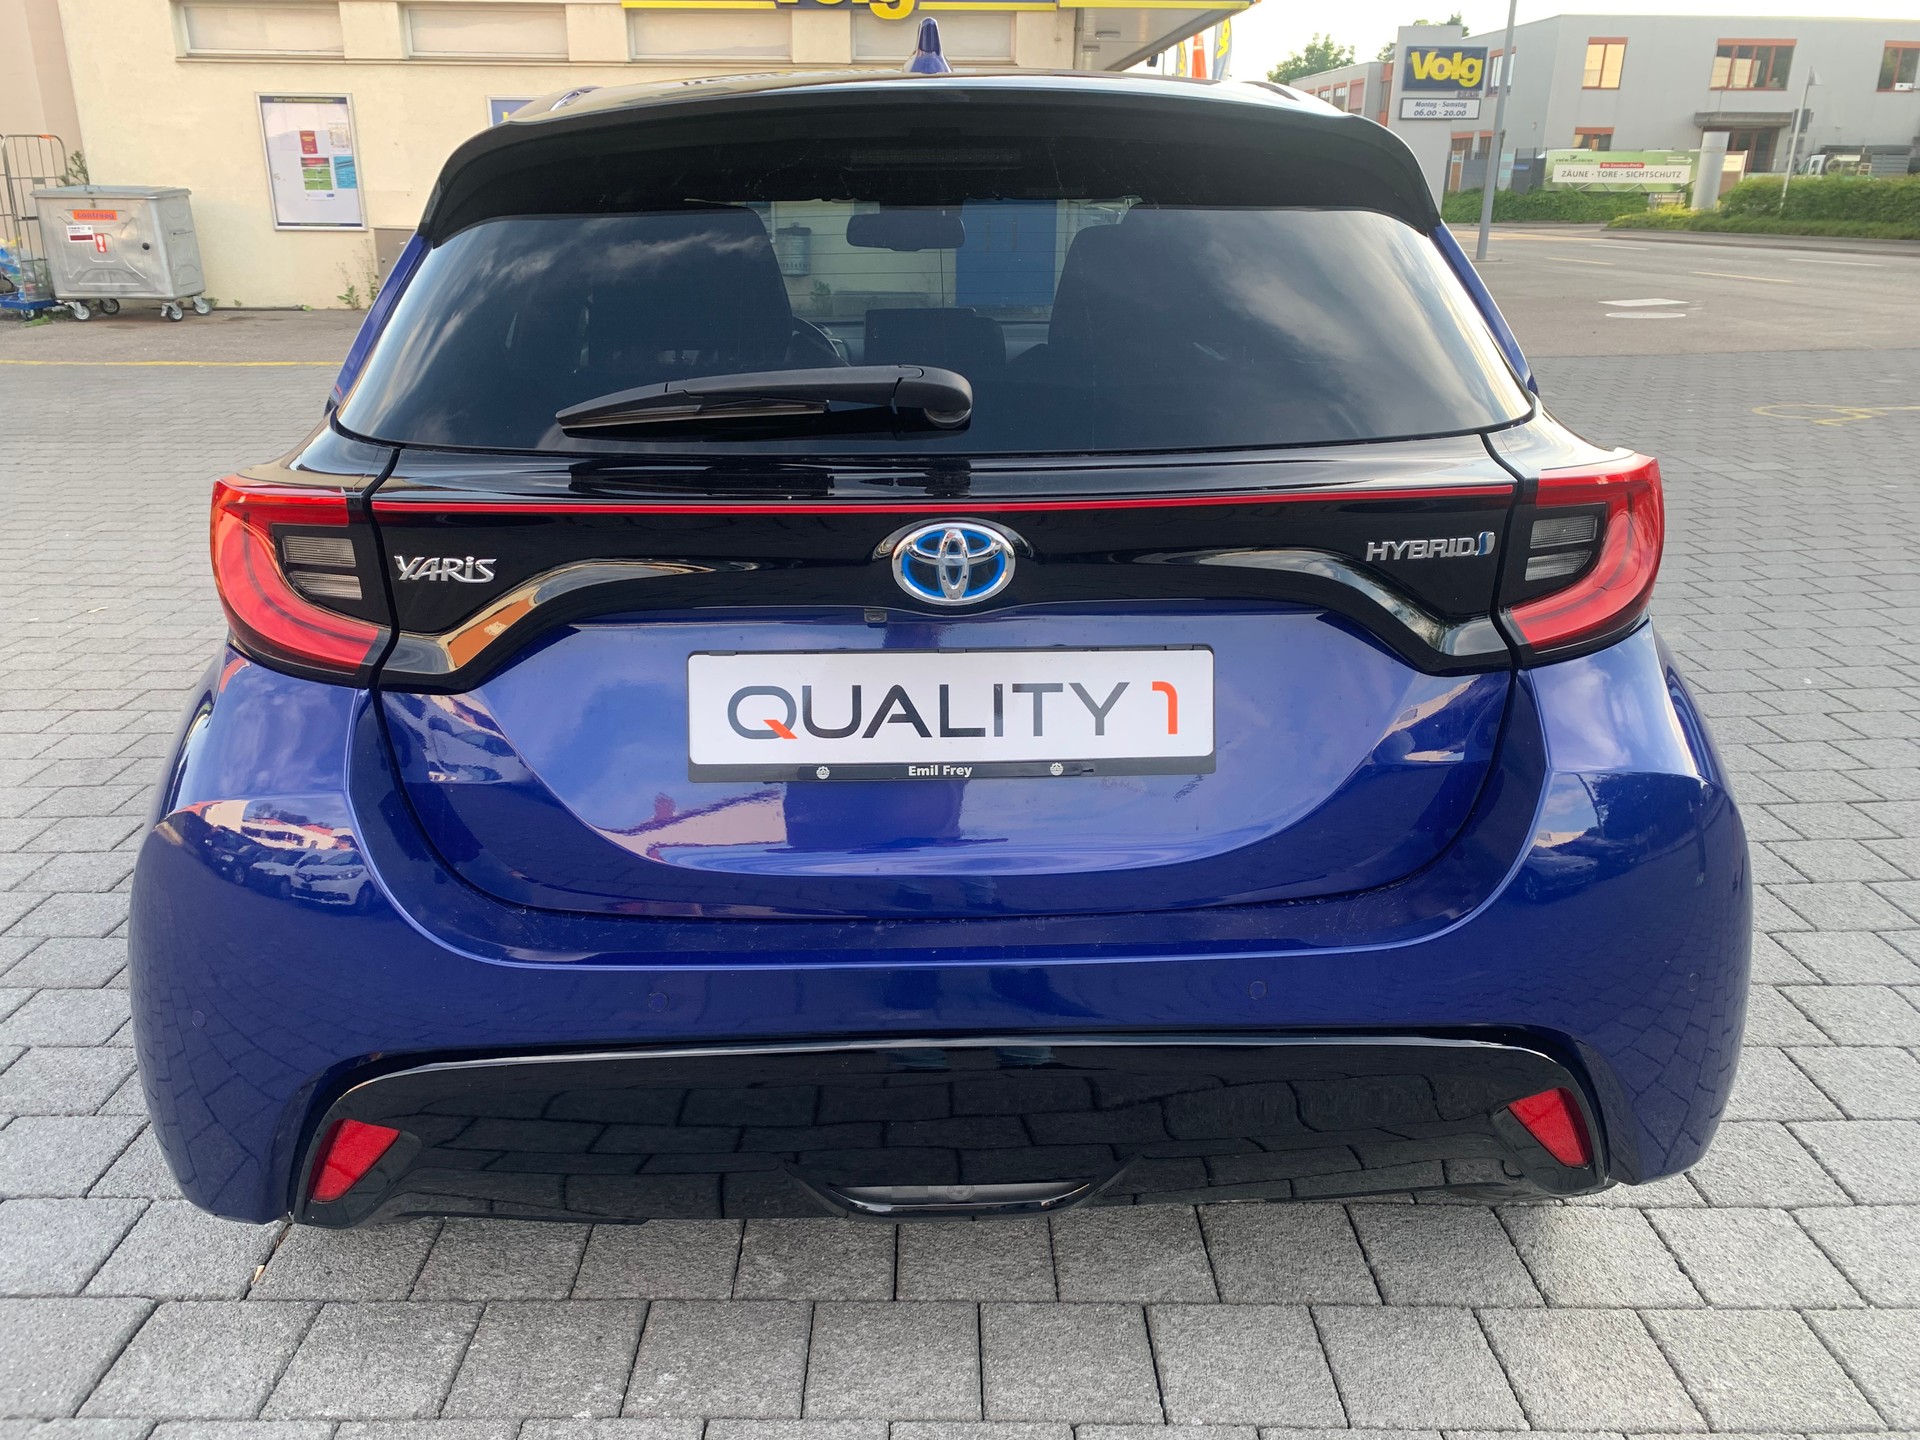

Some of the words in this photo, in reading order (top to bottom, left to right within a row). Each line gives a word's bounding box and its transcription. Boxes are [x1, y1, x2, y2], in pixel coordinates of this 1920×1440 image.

[1411, 51, 1483, 88] Volg
[1366, 537, 1475, 561] HYBRID
[727, 682, 1130, 739] QUALITY
[1152, 681, 1178, 735] 1
[908, 765, 939, 777] Emil
[943, 765, 973, 778] Frey
